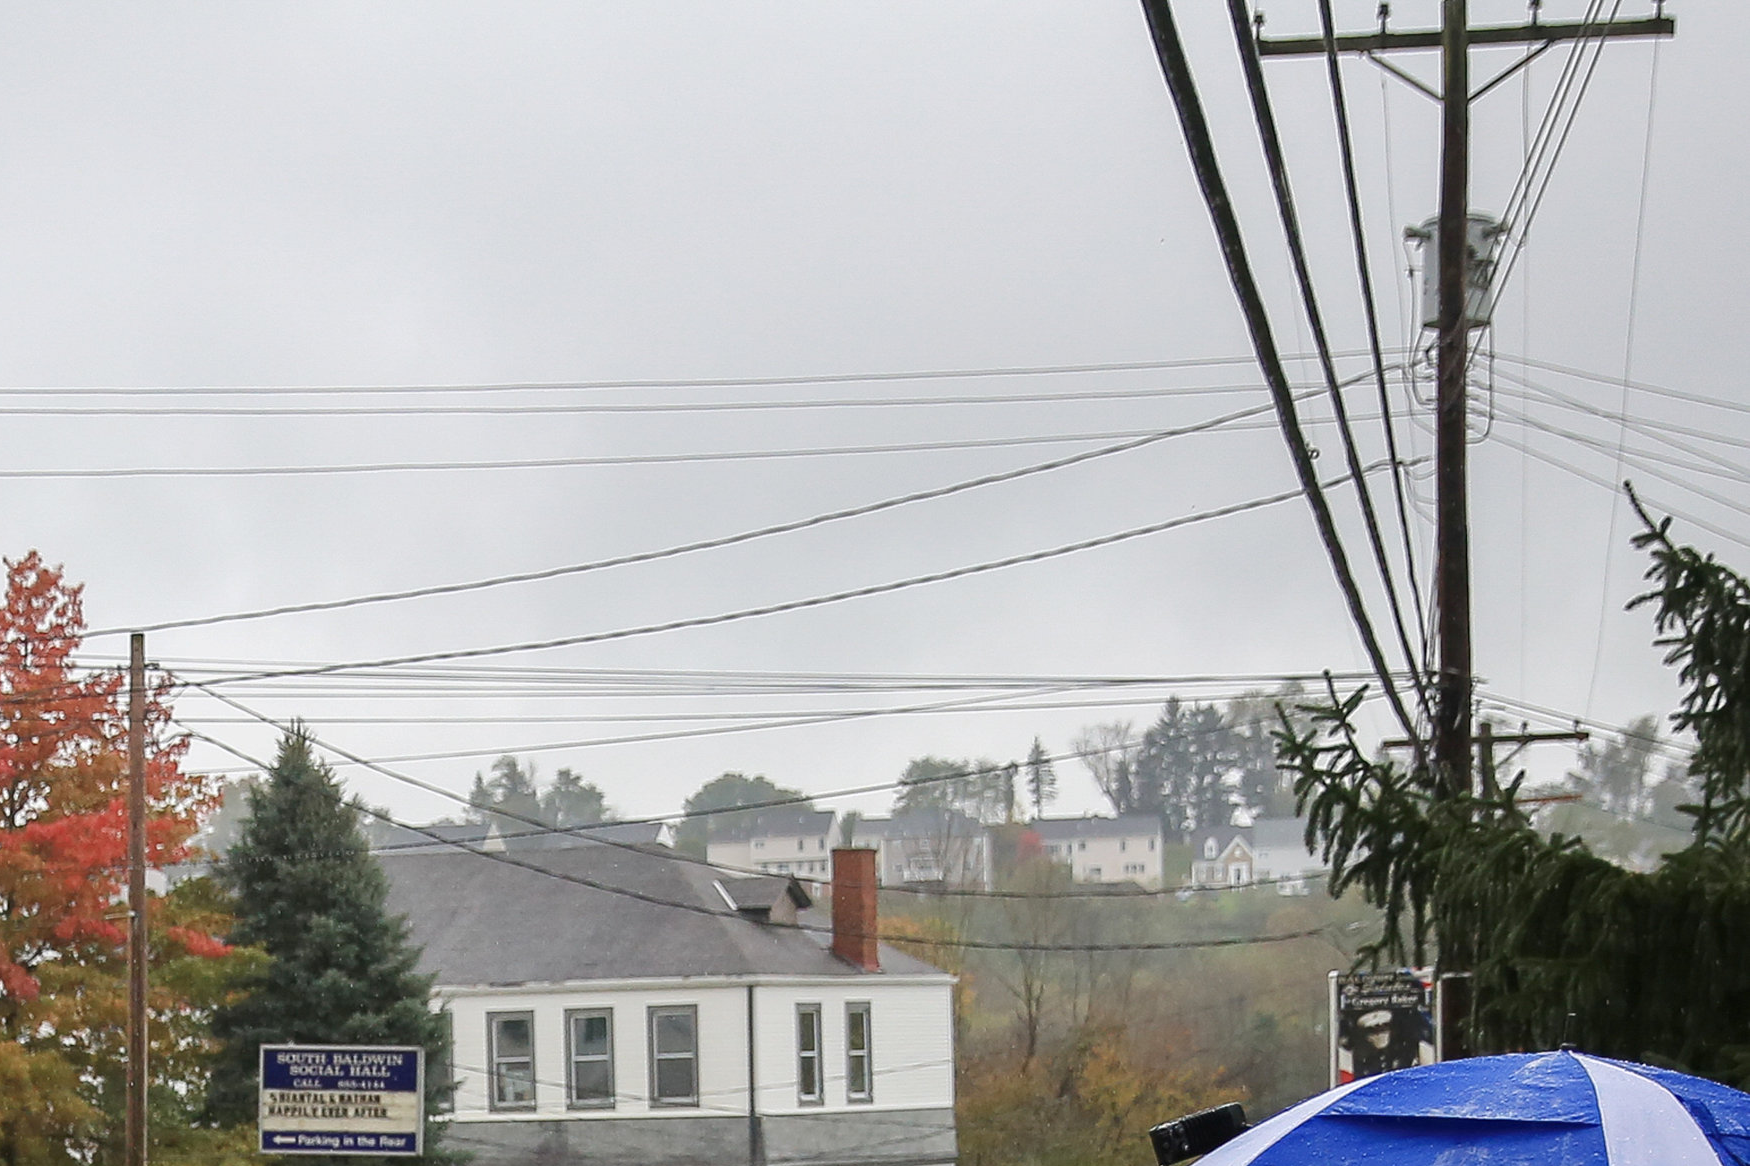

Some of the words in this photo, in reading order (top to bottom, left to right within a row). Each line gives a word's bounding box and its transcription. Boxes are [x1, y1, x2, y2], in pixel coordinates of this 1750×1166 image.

[277, 1053, 327, 1065] SOUTH
[333, 1053, 403, 1066] BALDWIN
[289, 1065, 344, 1077] SOCIAL
[350, 1066, 390, 1077] HALL
[293, 1080, 322, 1089] CALL
[339, 1094, 381, 1105] NATHAN
[268, 1105, 318, 1118] HAPPILY
[321, 1106, 349, 1119] EVER
[353, 1107, 388, 1119] AFTER
[298, 1135, 340, 1147] Parking
[344, 1135, 354, 1146] in
[357, 1136, 376, 1147] the
[380, 1136, 406, 1148] Rear
